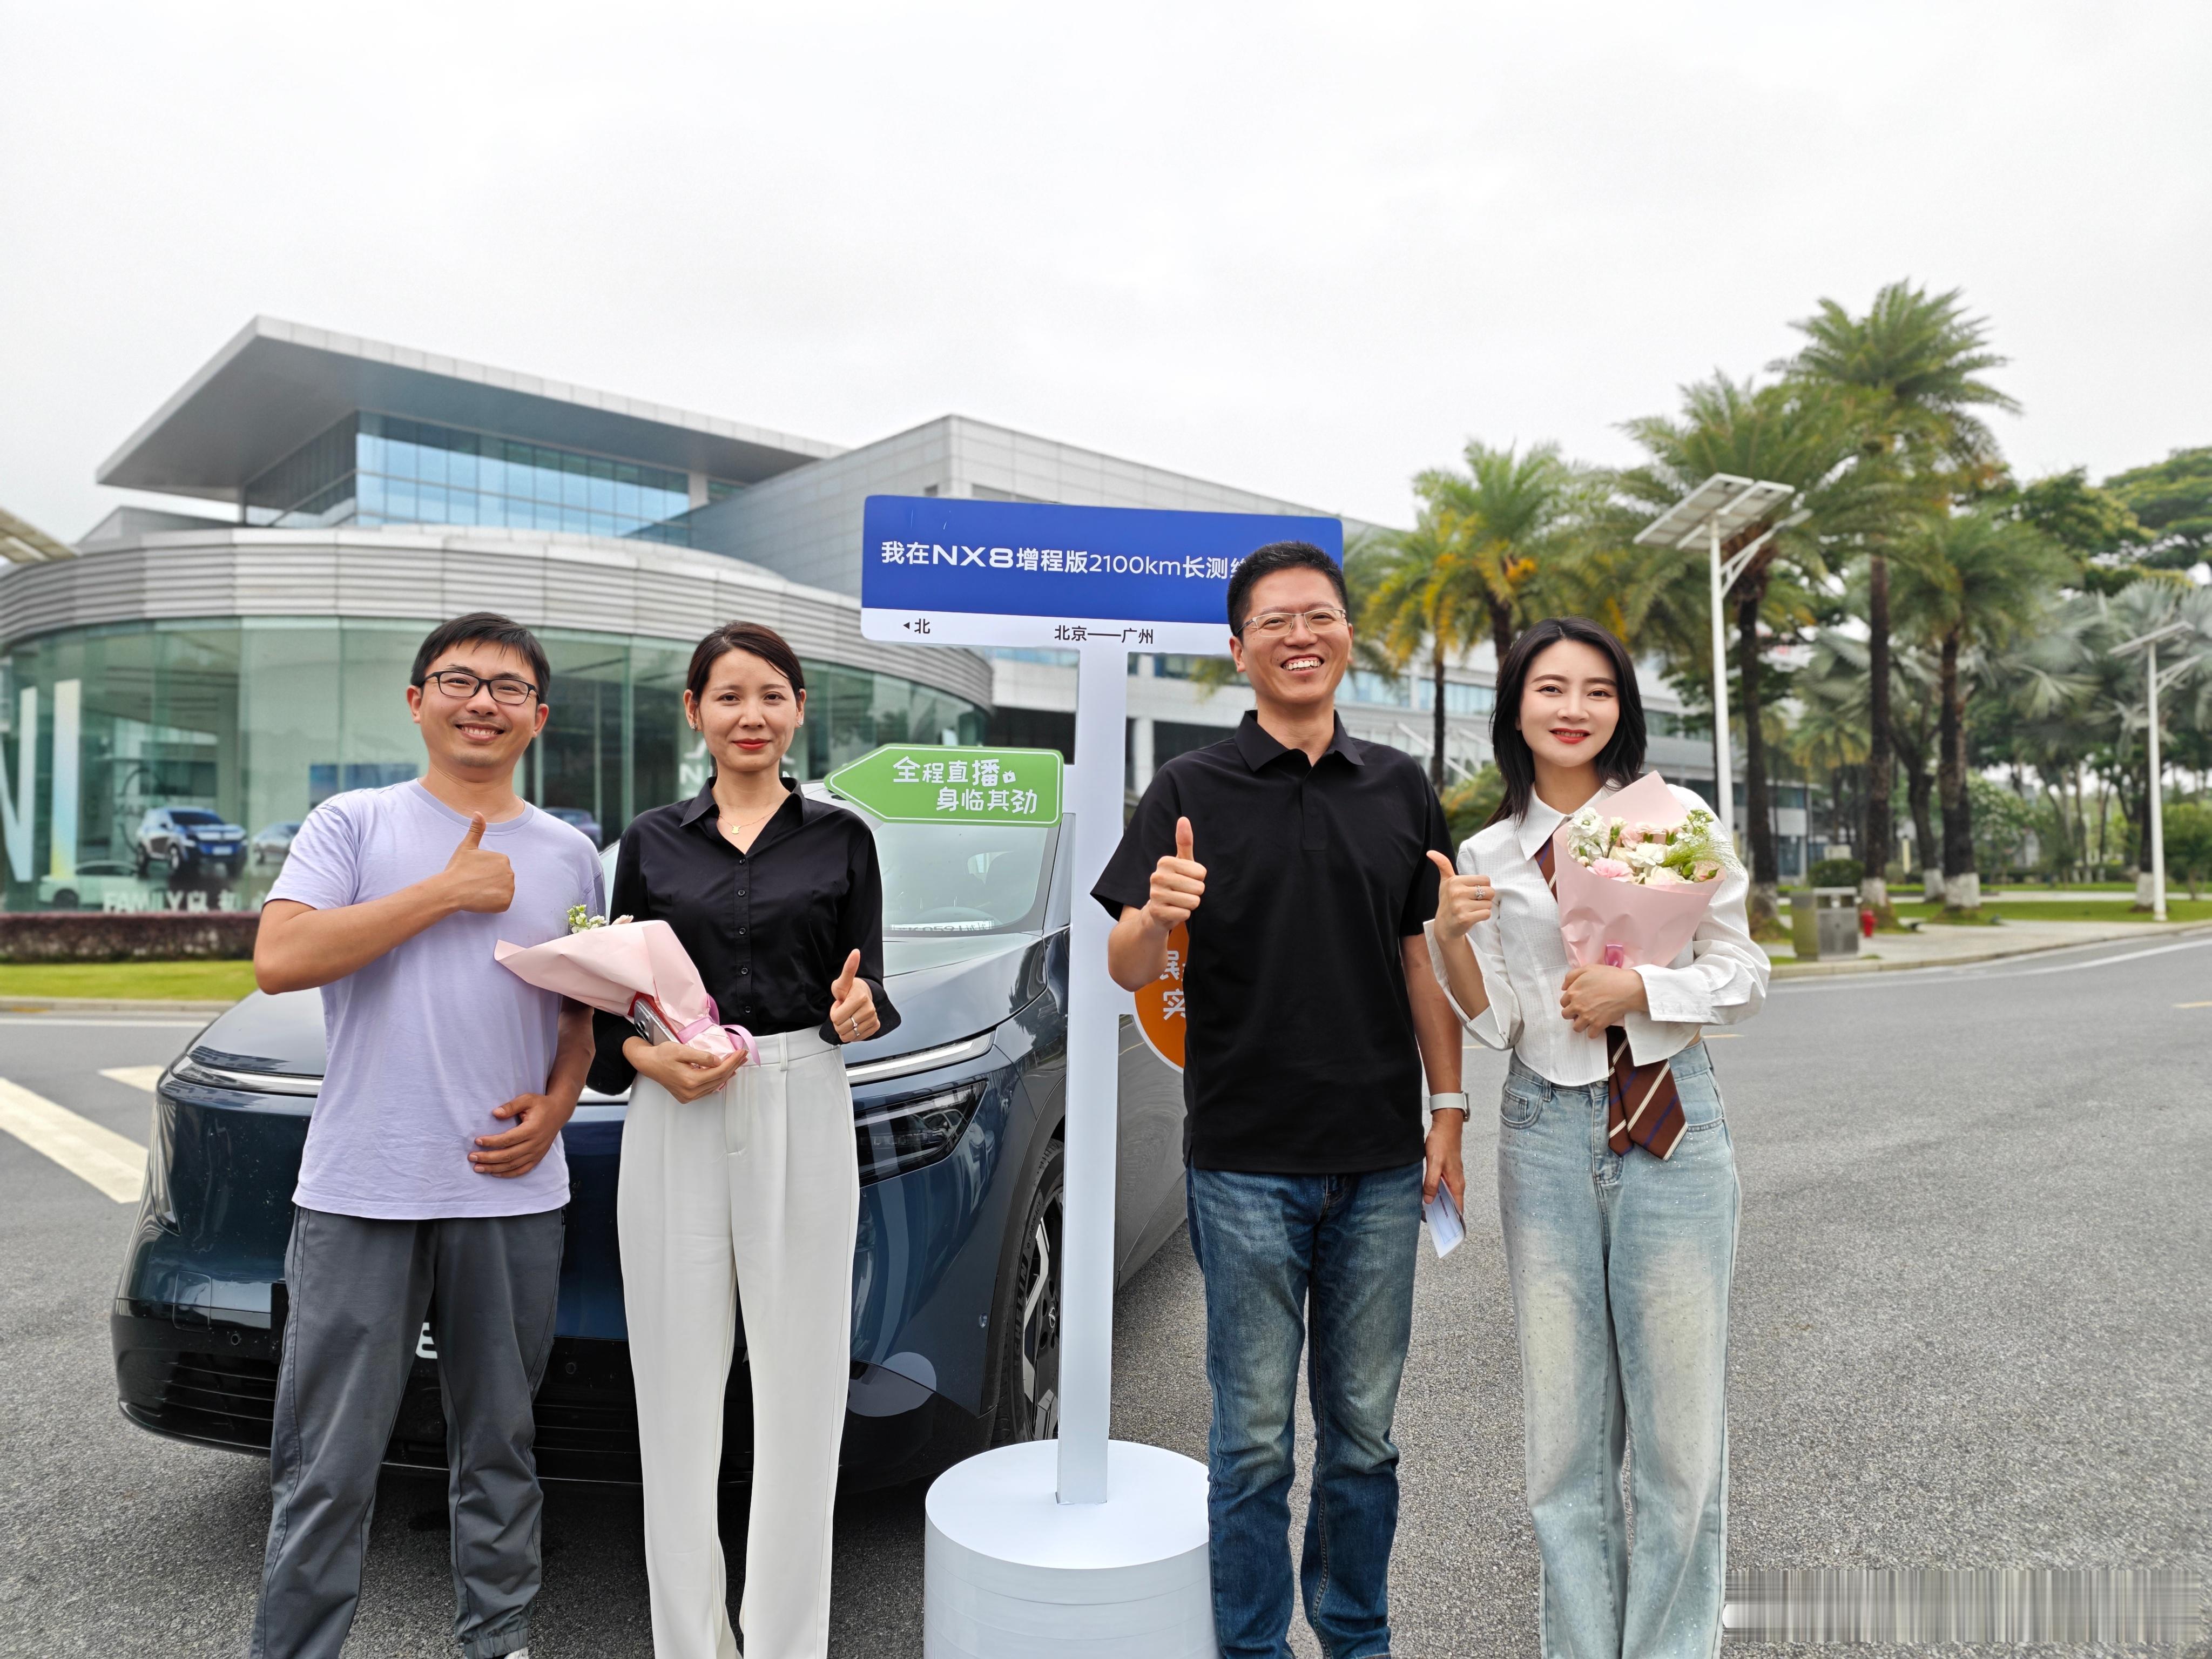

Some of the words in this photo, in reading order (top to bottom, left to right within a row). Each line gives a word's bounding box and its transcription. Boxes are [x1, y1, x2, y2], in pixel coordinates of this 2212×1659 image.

[881, 541, 1245, 580] 我在NX8增程版2100km长测
[914, 618, 930, 634] 北
[893, 756, 1000, 787] 全程直播
[936, 786, 1037, 815] 身临其劲
